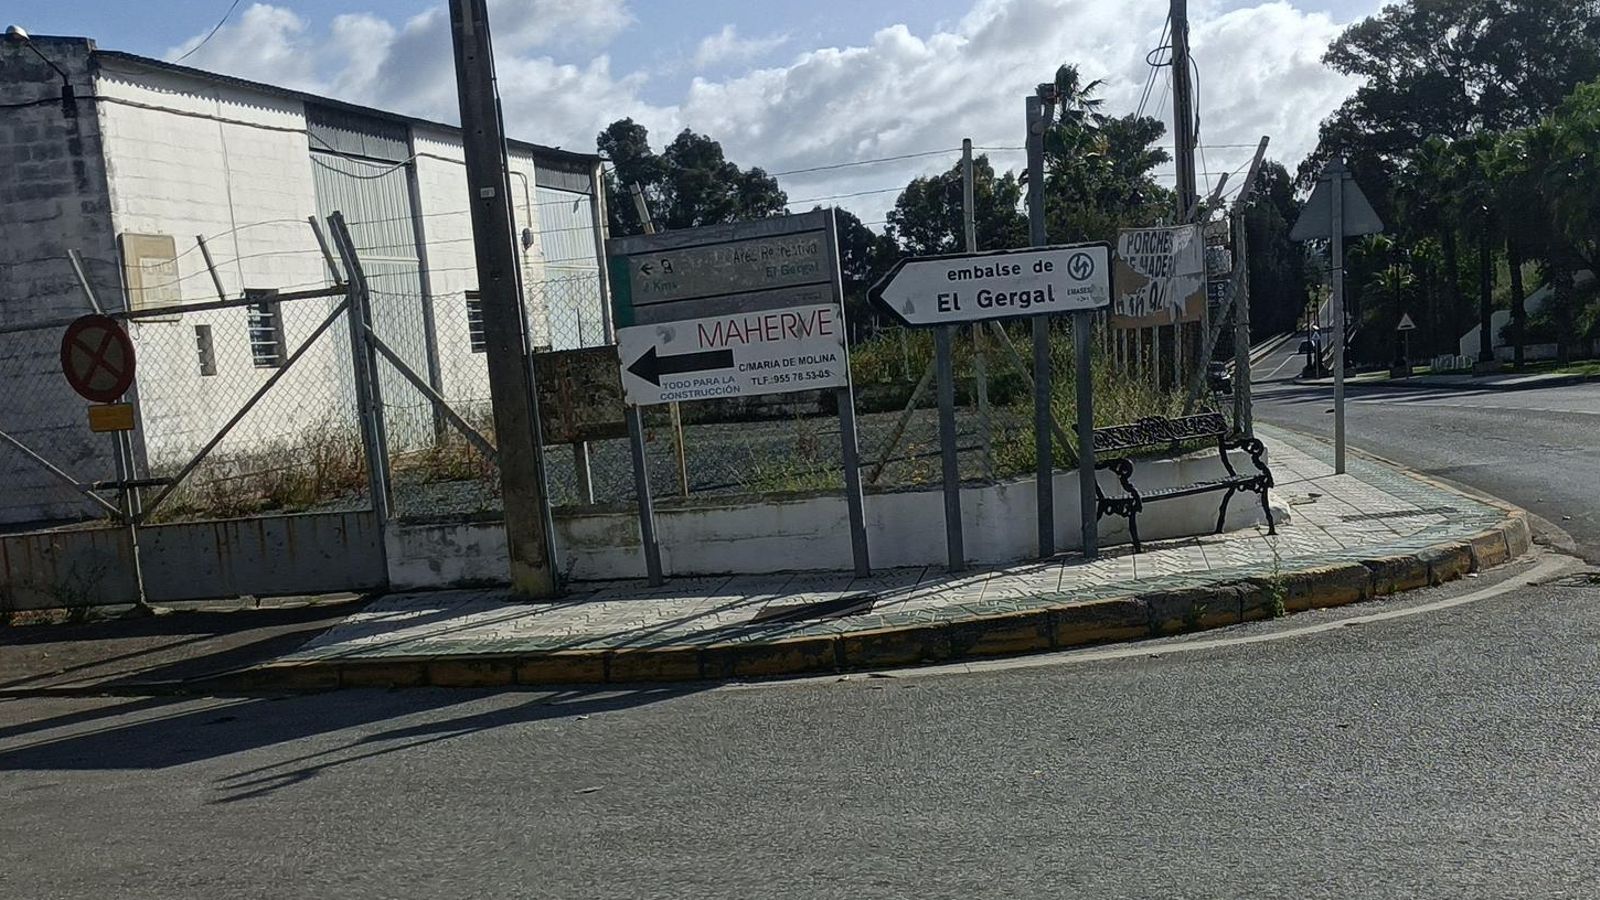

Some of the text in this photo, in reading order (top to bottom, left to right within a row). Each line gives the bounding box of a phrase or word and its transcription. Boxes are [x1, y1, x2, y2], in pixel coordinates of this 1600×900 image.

[1127, 231, 1174, 254] PORCHES
[947, 260, 1053, 281] embalse de
[937, 284, 1056, 313] El Gergal
[697, 308, 833, 348] MAHERVE
[783, 358, 795, 367] DE
[798, 353, 837, 366] MOLINA
[659, 385, 741, 401] CONSTRUCCIÓN
[662, 375, 736, 390] TODO PARA LA
